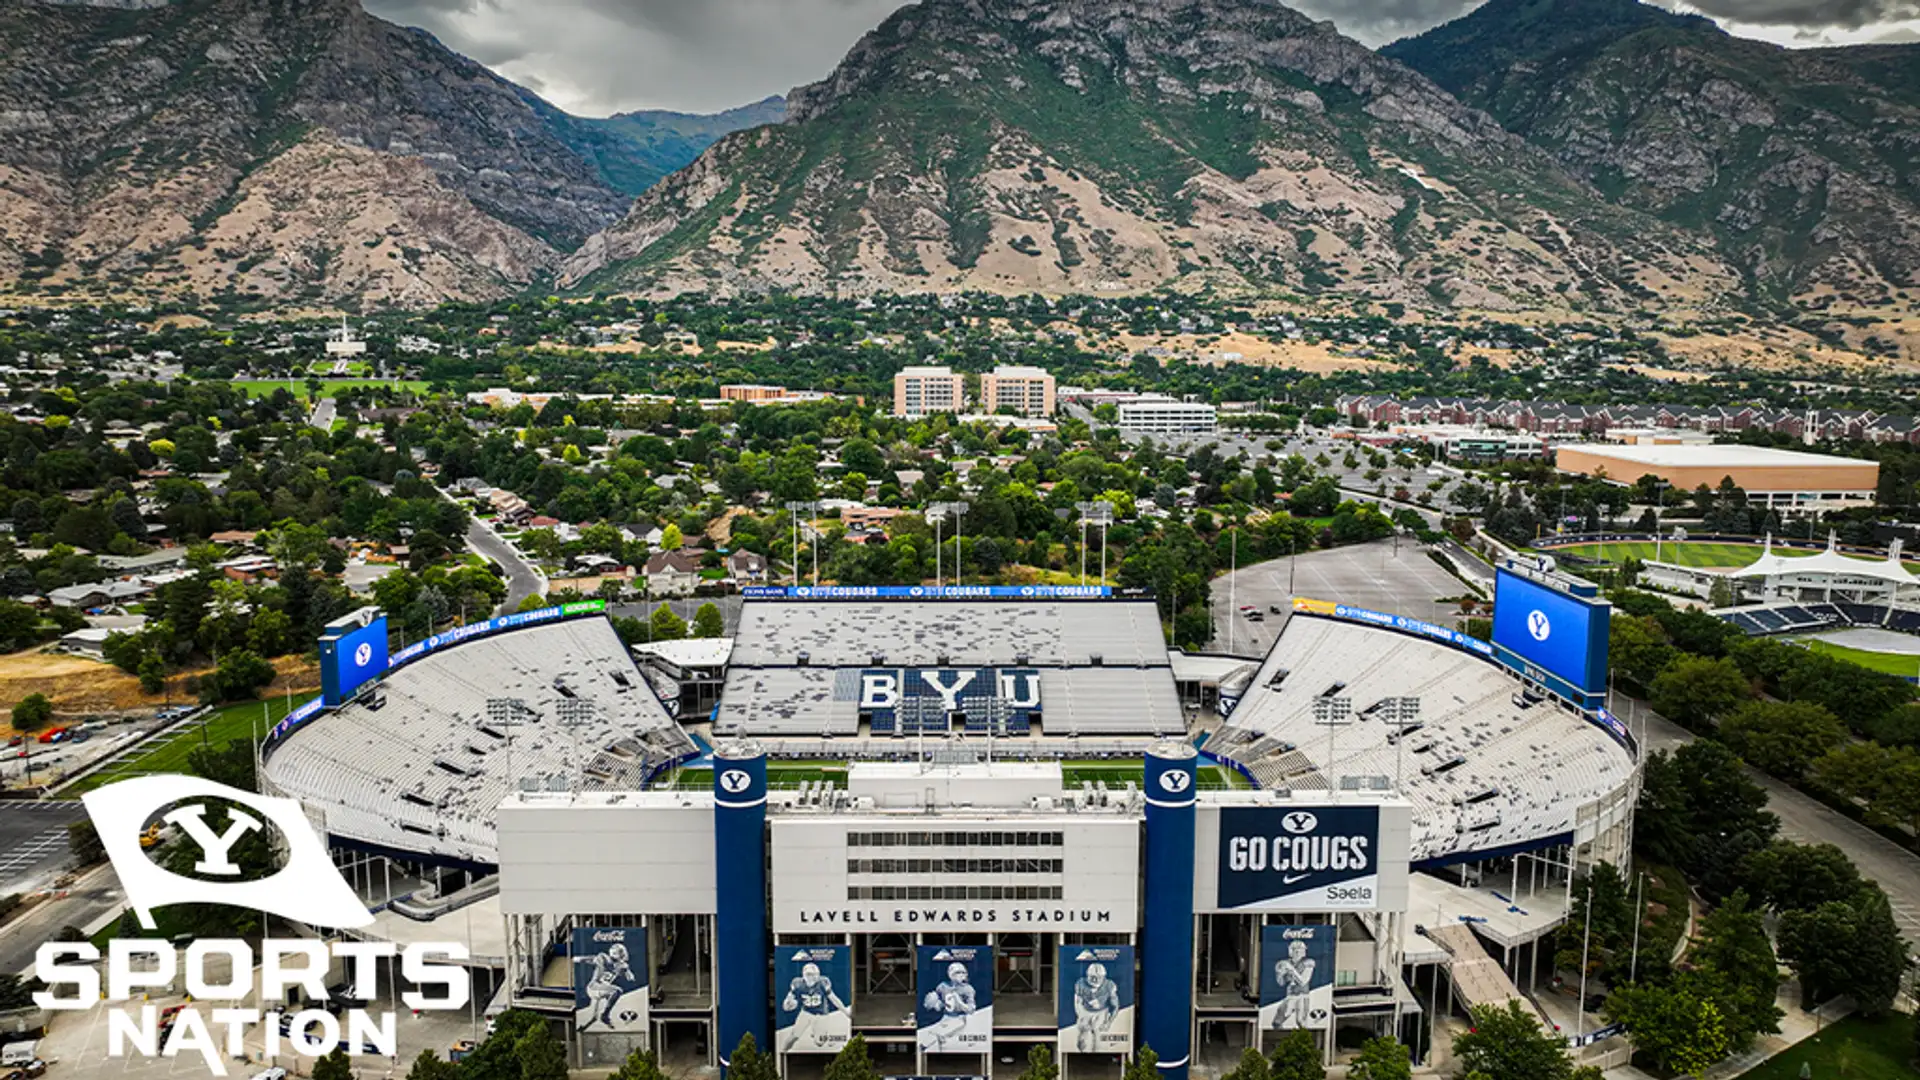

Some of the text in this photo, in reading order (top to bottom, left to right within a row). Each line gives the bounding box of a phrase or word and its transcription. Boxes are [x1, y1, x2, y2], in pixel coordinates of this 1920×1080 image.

[832, 587, 877, 596] COUGARS
[945, 587, 991, 596] COUGARS
[1056, 587, 1102, 596] COUGARS
[860, 671, 1040, 710] BYU
[725, 772, 746, 790] Y
[1164, 772, 1186, 790] Y
[1288, 813, 1313, 830] Y
[1229, 835, 1368, 871] GO COUGS
[1326, 886, 1372, 900] Saela
[800, 910, 1111, 923] LAVELL EDWARDS STADIUM
